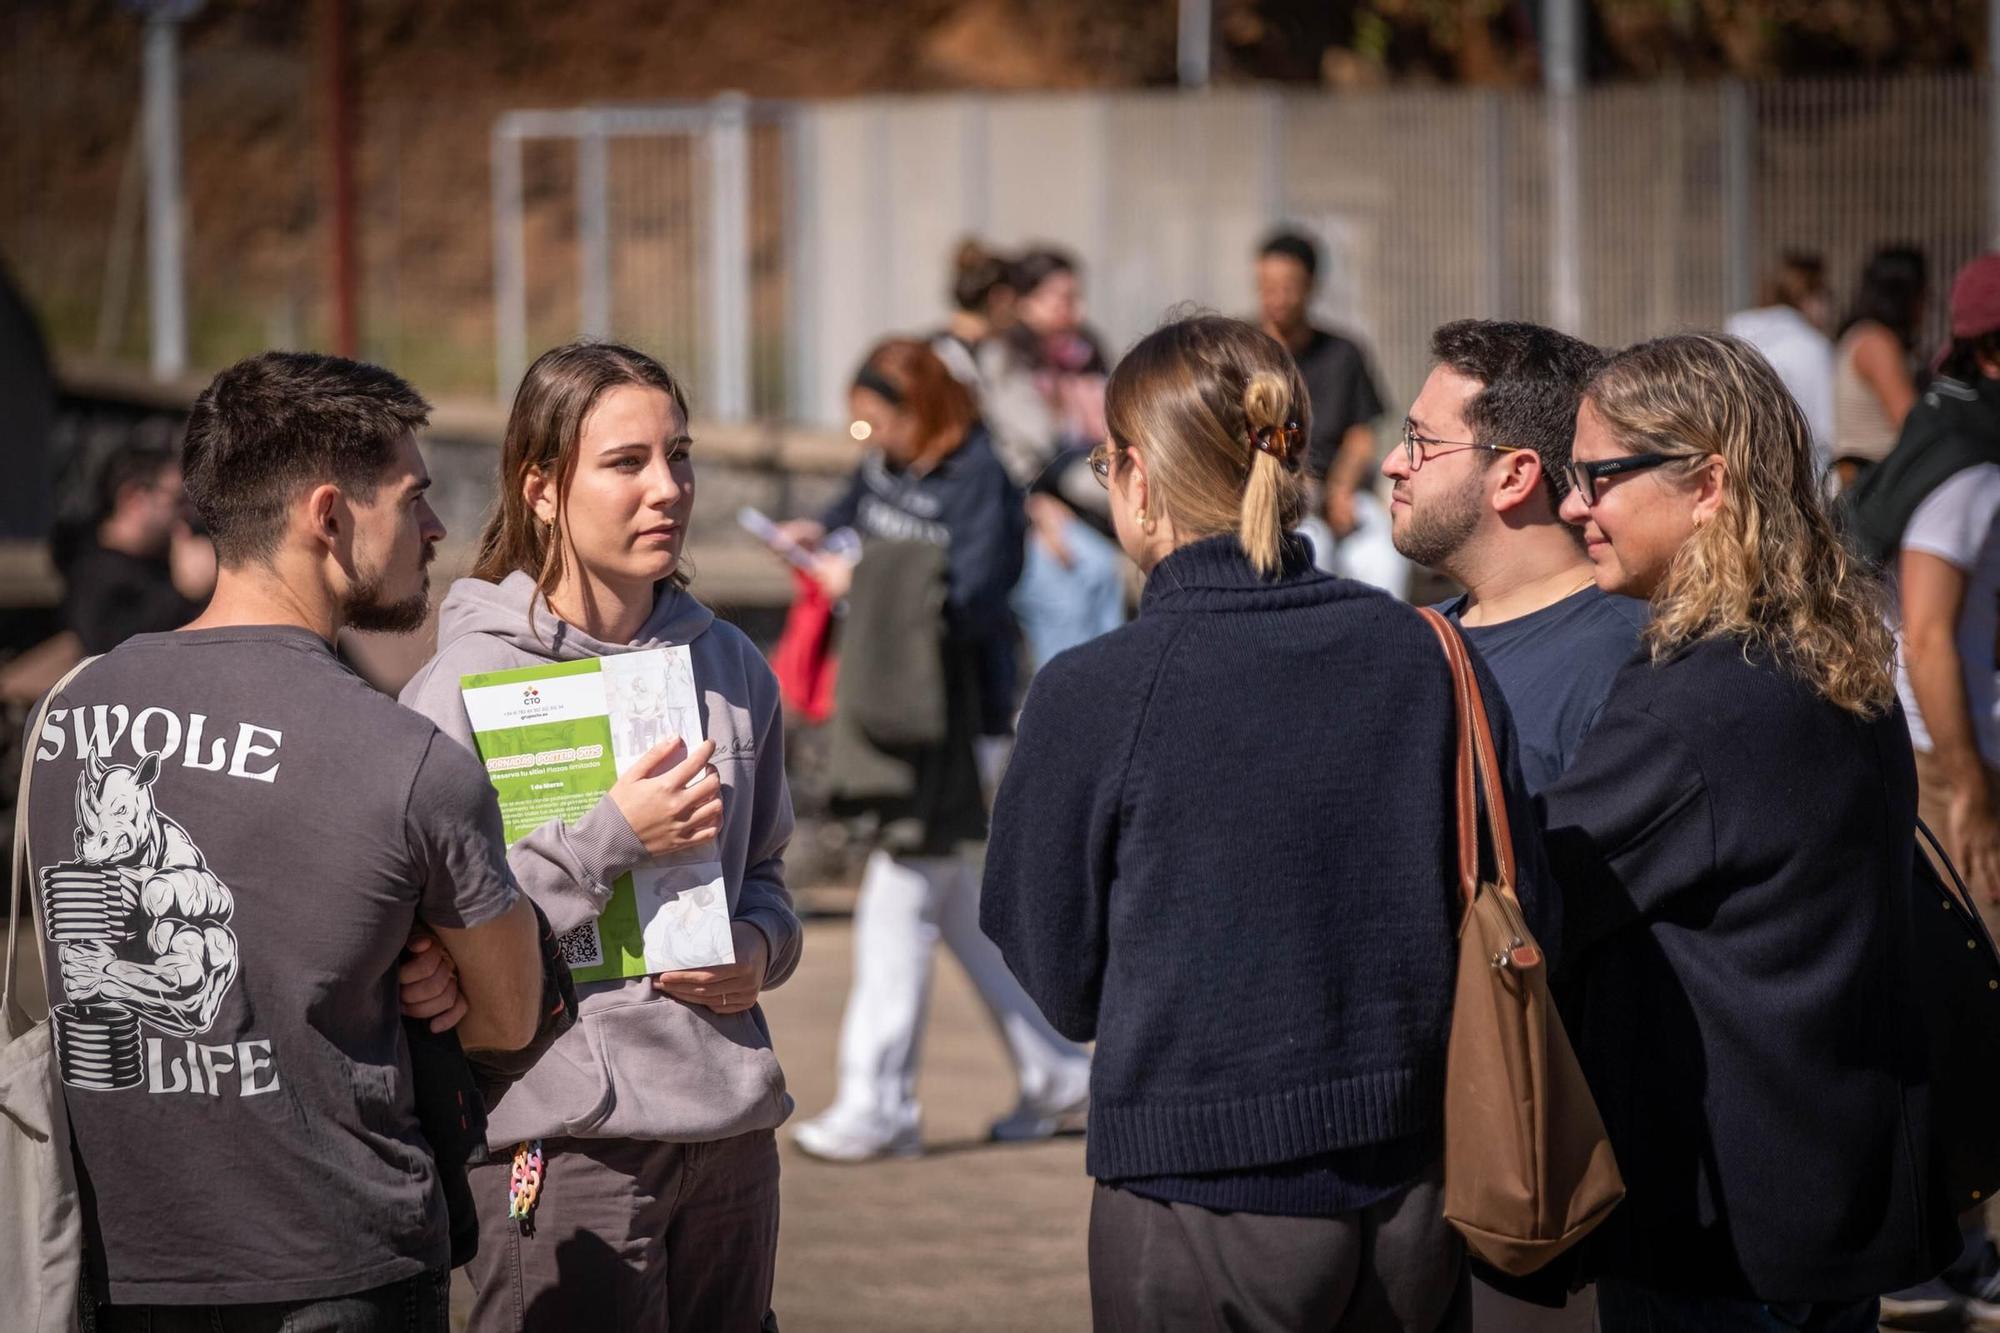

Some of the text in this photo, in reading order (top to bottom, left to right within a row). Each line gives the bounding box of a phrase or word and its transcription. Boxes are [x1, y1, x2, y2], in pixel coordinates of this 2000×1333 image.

[523, 696, 541, 705] CTO
[36, 704, 283, 783] SWOLE
[146, 1037, 281, 1098] LIFE
